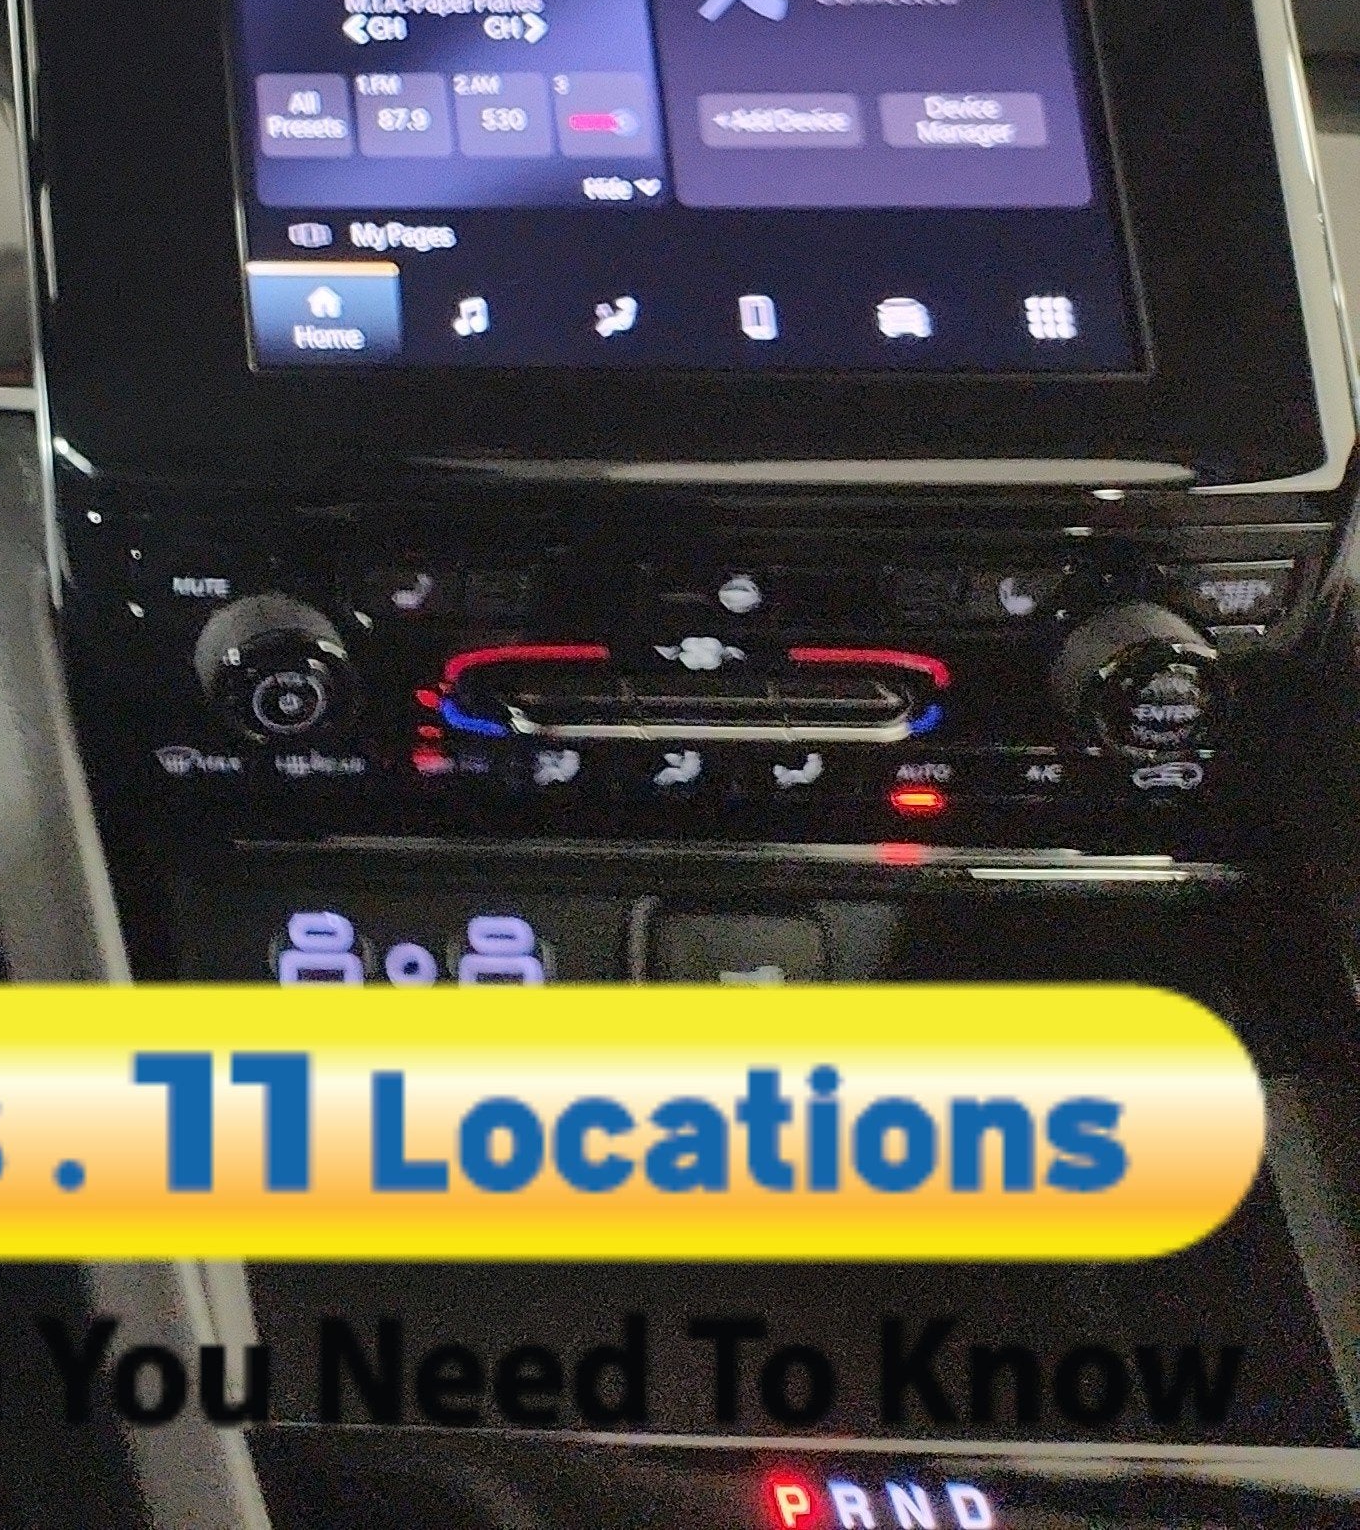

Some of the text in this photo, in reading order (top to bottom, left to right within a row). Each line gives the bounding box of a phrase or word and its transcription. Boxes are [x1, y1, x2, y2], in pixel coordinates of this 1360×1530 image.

[366, 17, 408, 41] CH
[483, 17, 523, 41] CH
[552, 74, 571, 96] 3
[288, 89, 322, 116] All
[924, 95, 1002, 120] Device
[266, 115, 348, 140] Presets
[377, 106, 432, 133] 87.9
[480, 106, 528, 133] 530
[774, 107, 851, 133] Device
[916, 120, 1018, 148] Manager
[349, 221, 458, 253] My Pages
[293, 324, 366, 350] Home
[172, 576, 230, 598] MUTE
[896, 763, 951, 782] AUTO
[774, 1480, 992, 1529] P R N D
